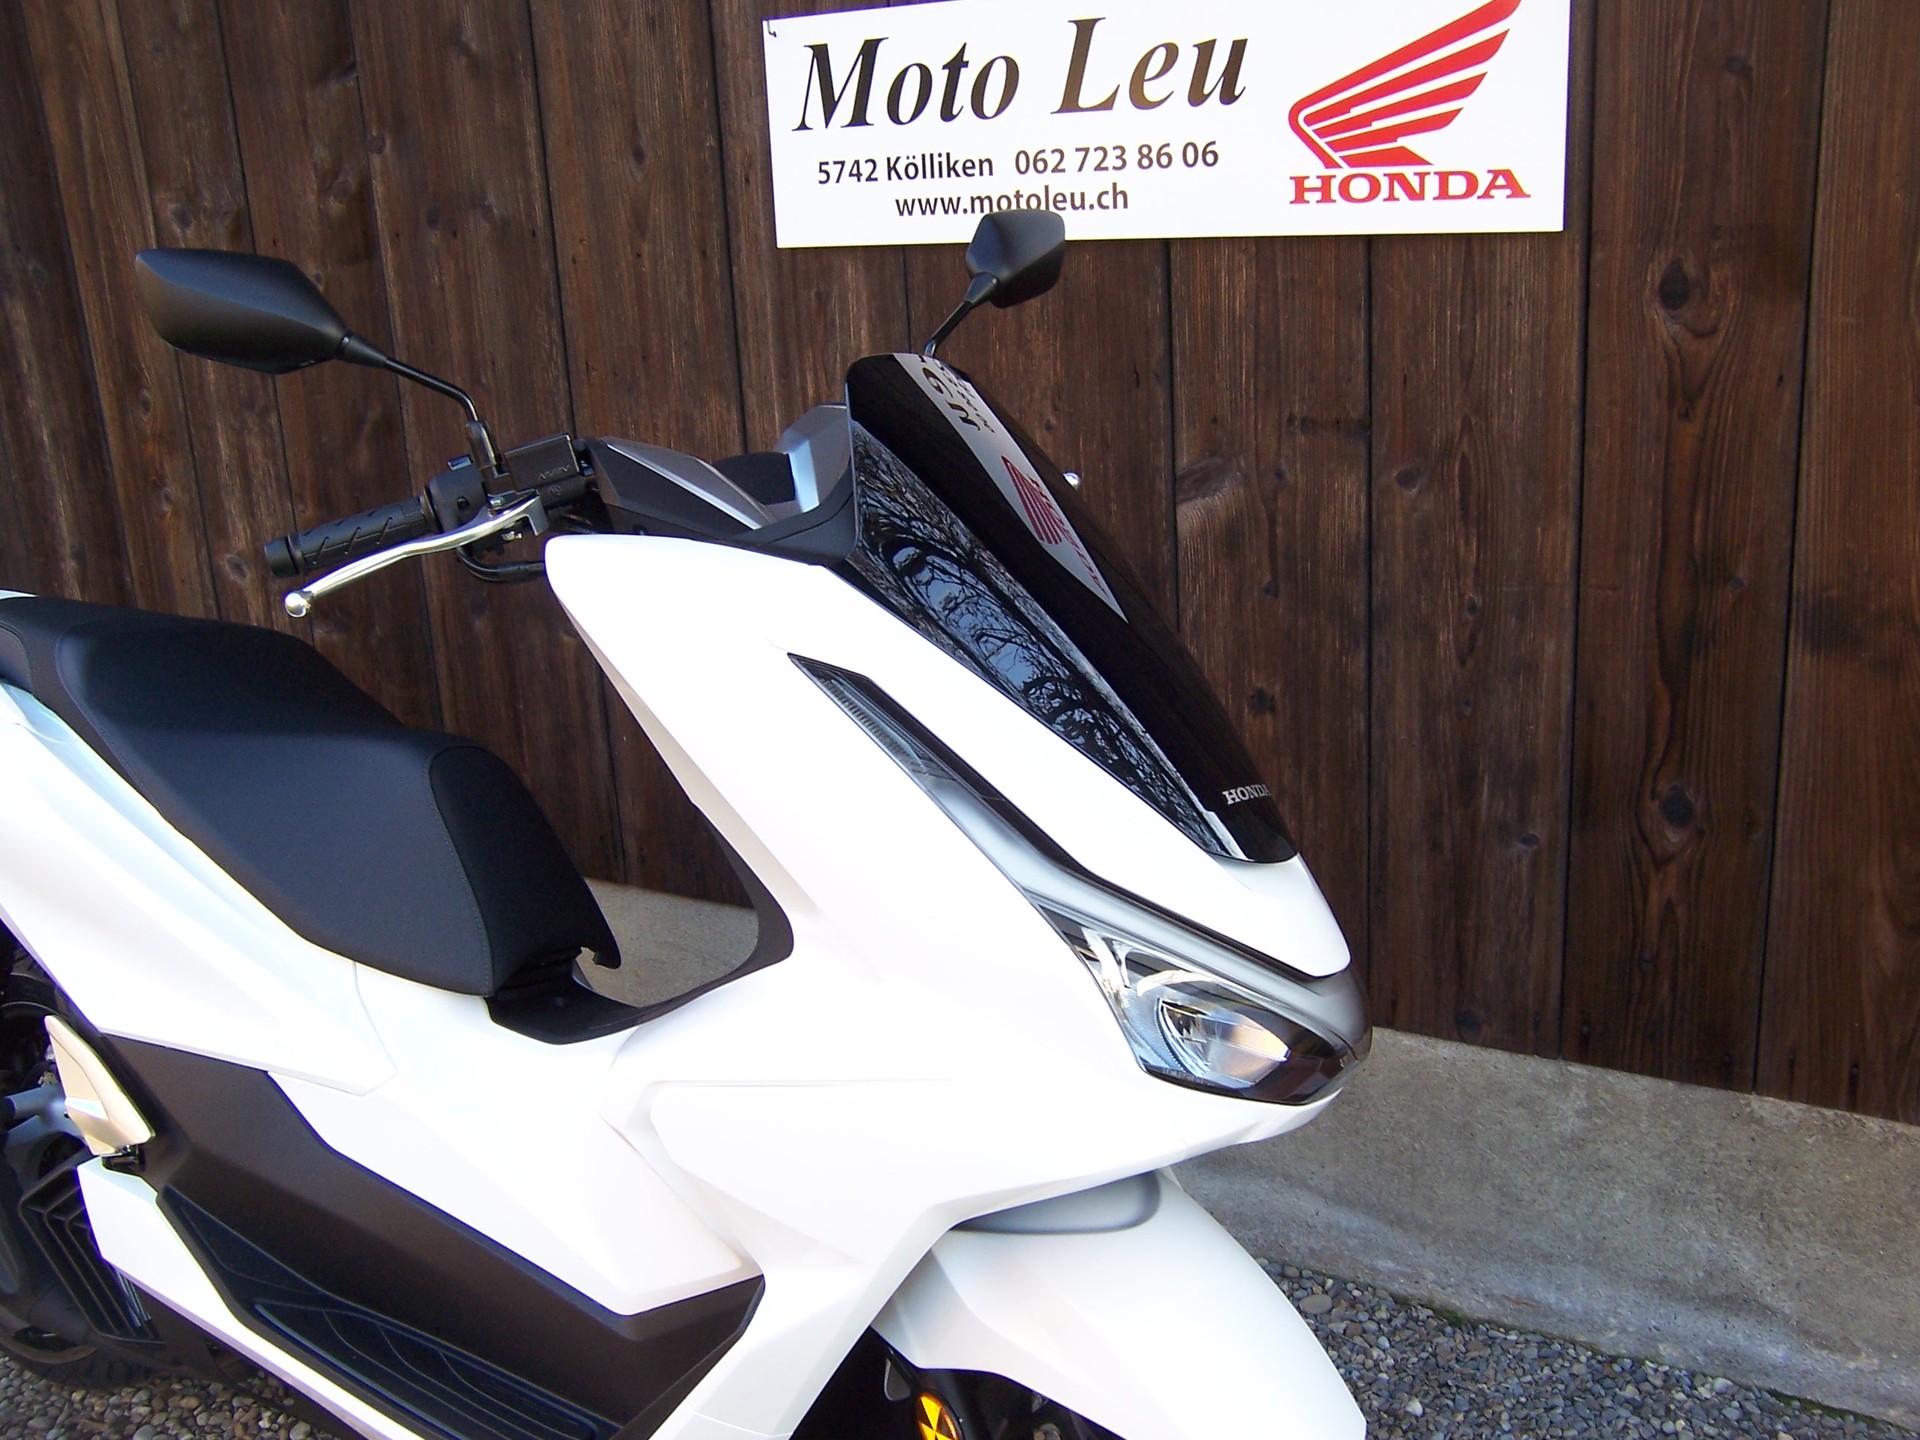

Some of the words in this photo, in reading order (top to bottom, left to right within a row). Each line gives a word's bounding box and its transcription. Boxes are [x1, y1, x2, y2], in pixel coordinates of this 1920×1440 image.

[791, 36, 1020, 132] Moto
[1050, 17, 1249, 115] Leu
[818, 158, 879, 185] 5742
[886, 151, 994, 181] Kölliken
[1015, 148, 1066, 175] 062
[1075, 145, 1127, 173] 723
[1137, 143, 1173, 170] 86
[1182, 140, 1219, 168] 06
[895, 182, 1129, 216] www.motoleu.ch
[1289, 168, 1531, 205] HONDA
[1222, 784, 1272, 805] HONDA
